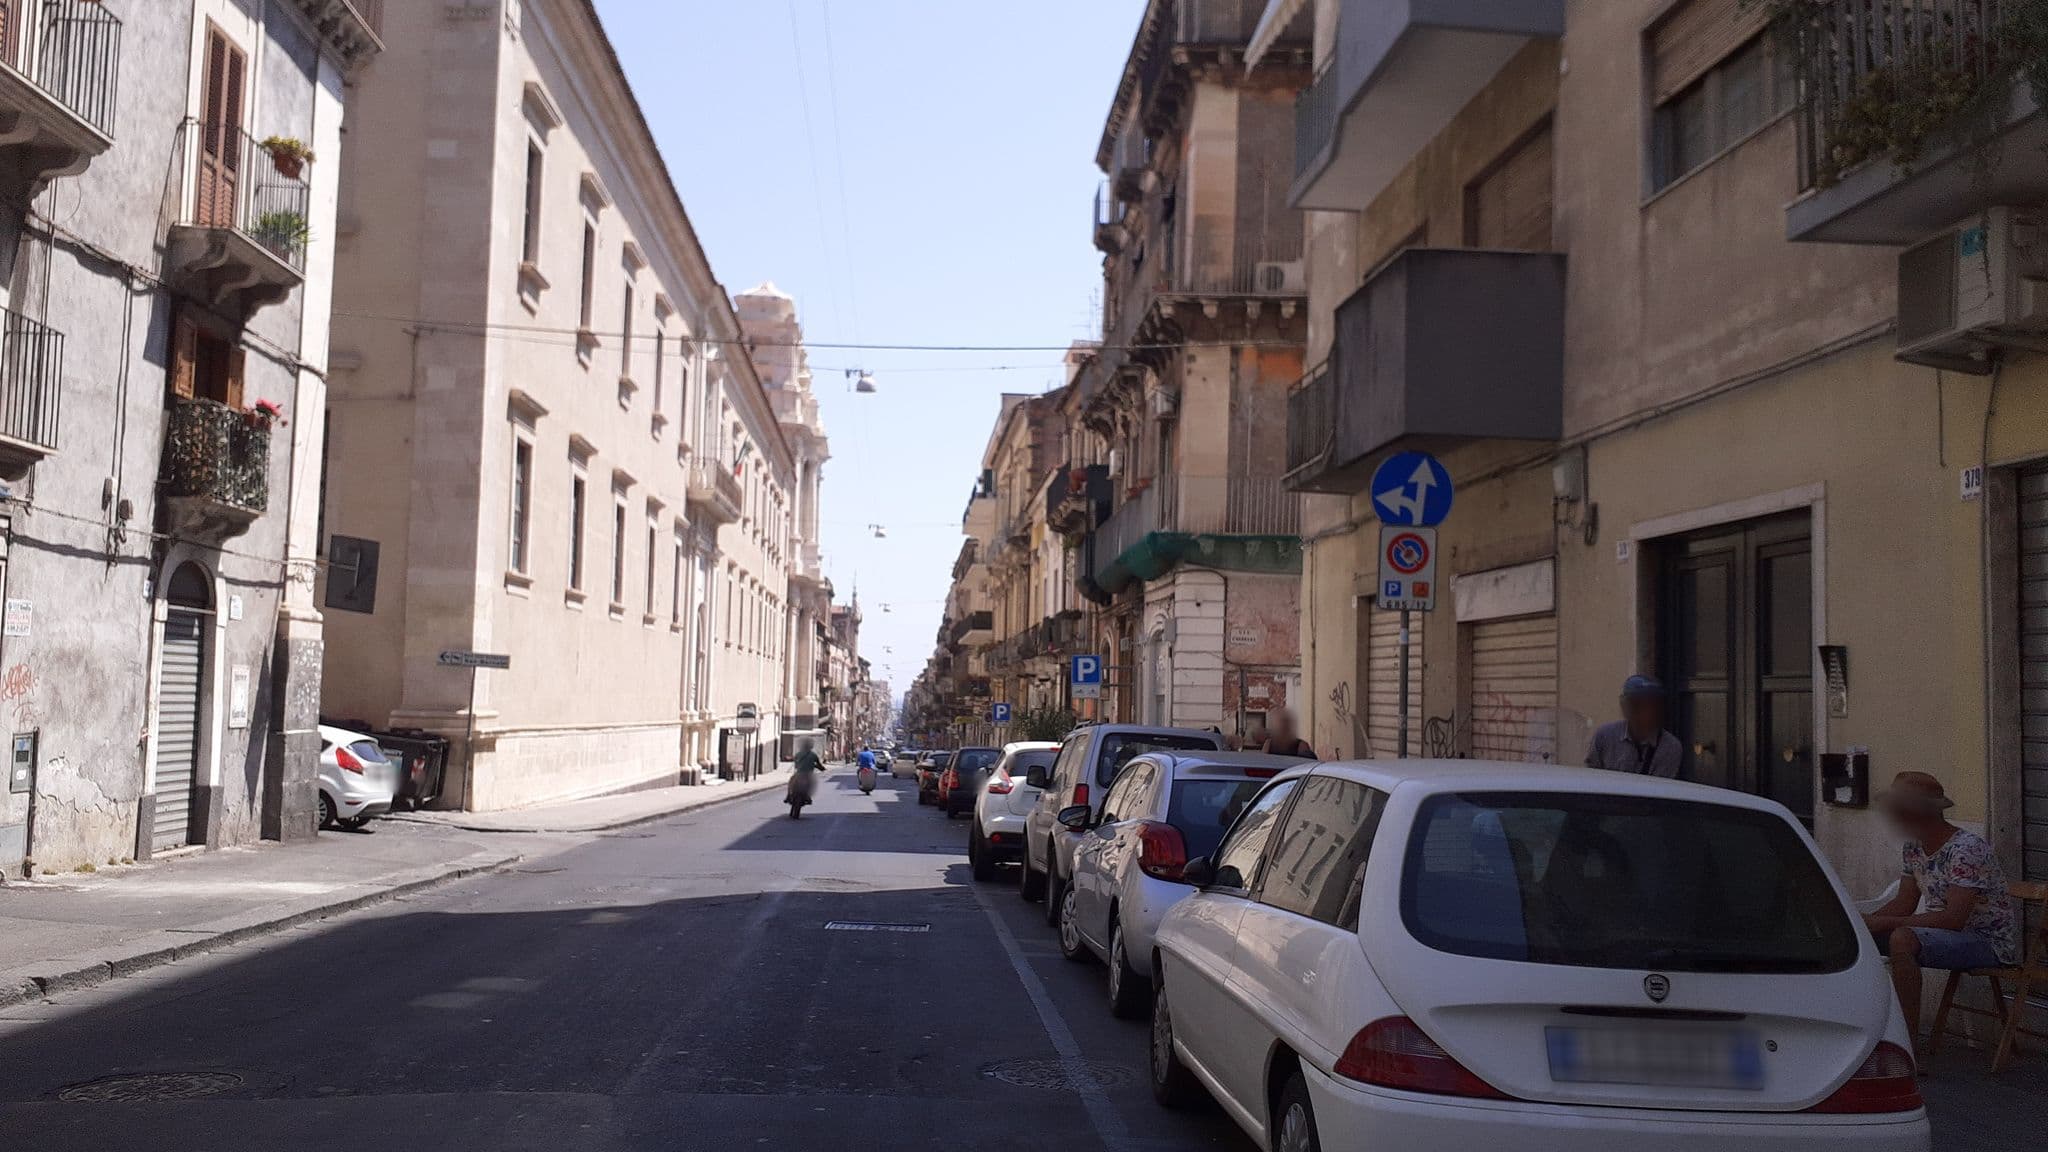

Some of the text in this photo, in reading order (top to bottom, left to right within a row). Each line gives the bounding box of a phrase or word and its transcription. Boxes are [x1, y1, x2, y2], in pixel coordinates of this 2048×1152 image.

[1964, 467, 1981, 489] 379
[1388, 582, 1399, 595] P
[1077, 657, 1096, 682] P
[996, 704, 1008, 719] P
